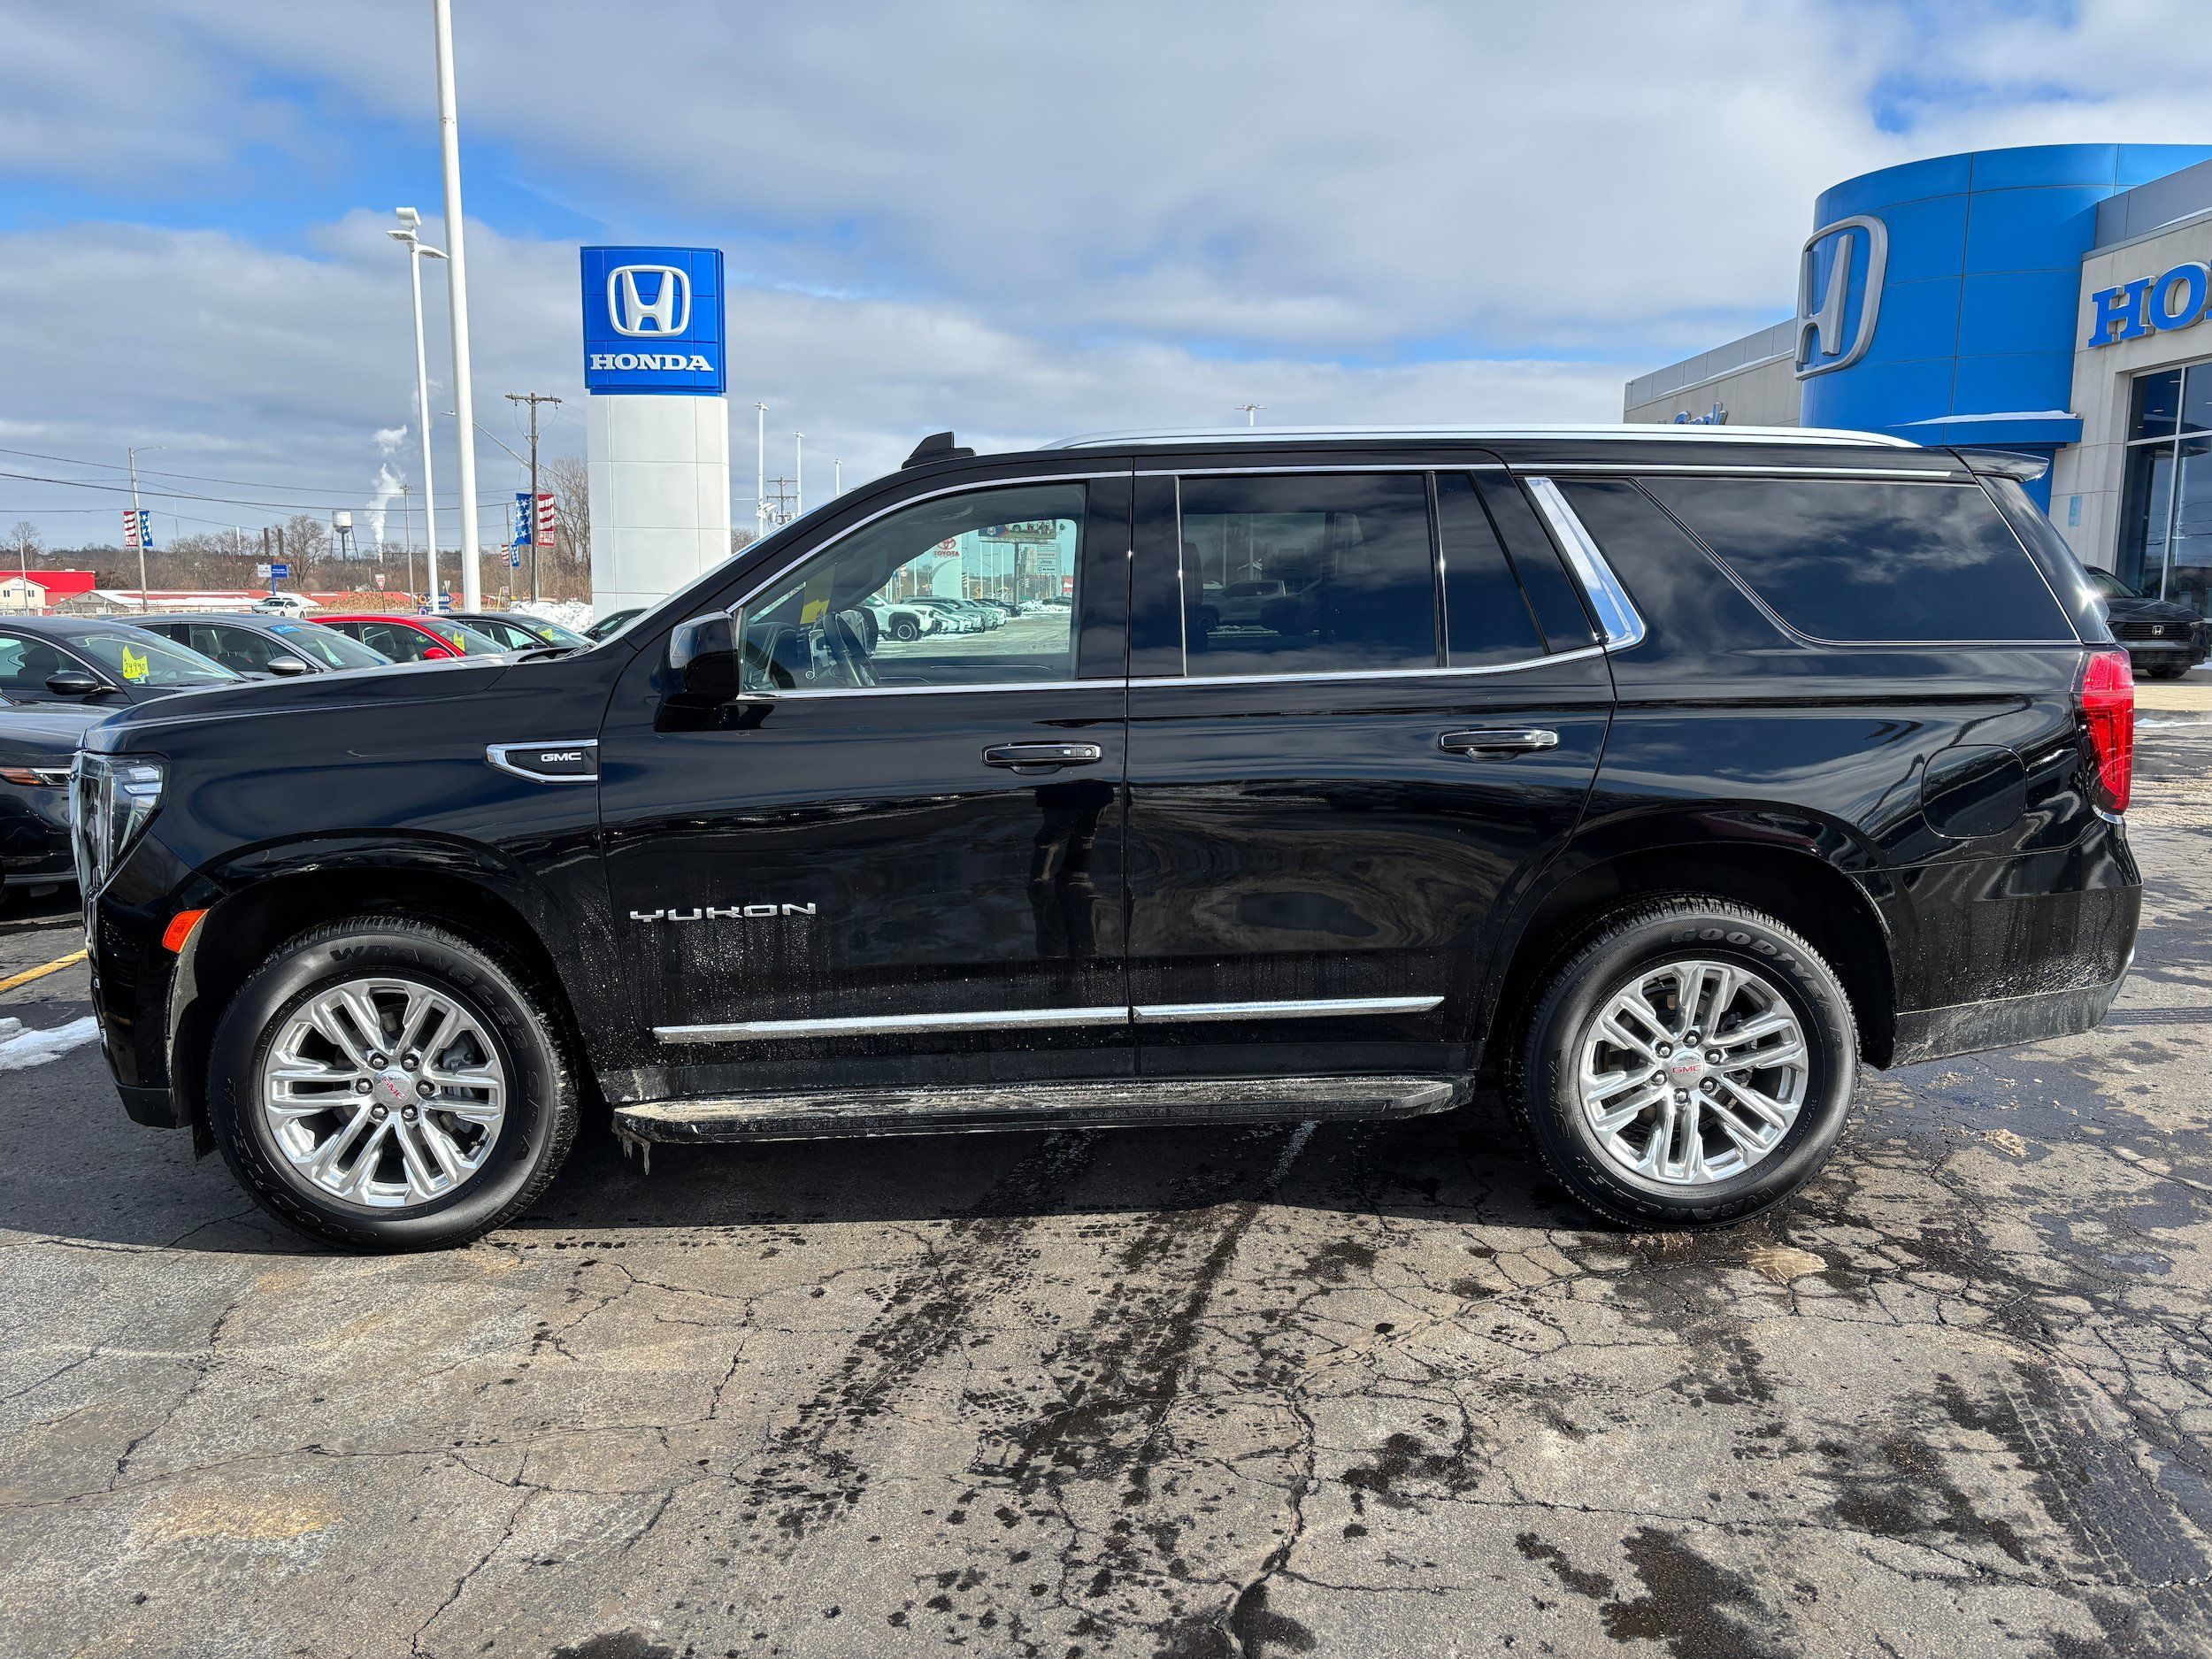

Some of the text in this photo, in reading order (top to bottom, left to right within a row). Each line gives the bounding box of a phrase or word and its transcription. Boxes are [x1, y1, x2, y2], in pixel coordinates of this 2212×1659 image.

[2088, 260, 2212, 349] HO
[590, 353, 714, 372] HONDA
[541, 752, 582, 763] GMC
[629, 902, 817, 923] YUKON
[1670, 927, 1844, 1054] GOODYEAR
[1671, 1064, 1701, 1073] GMC
[380, 1075, 406, 1102] GMC
